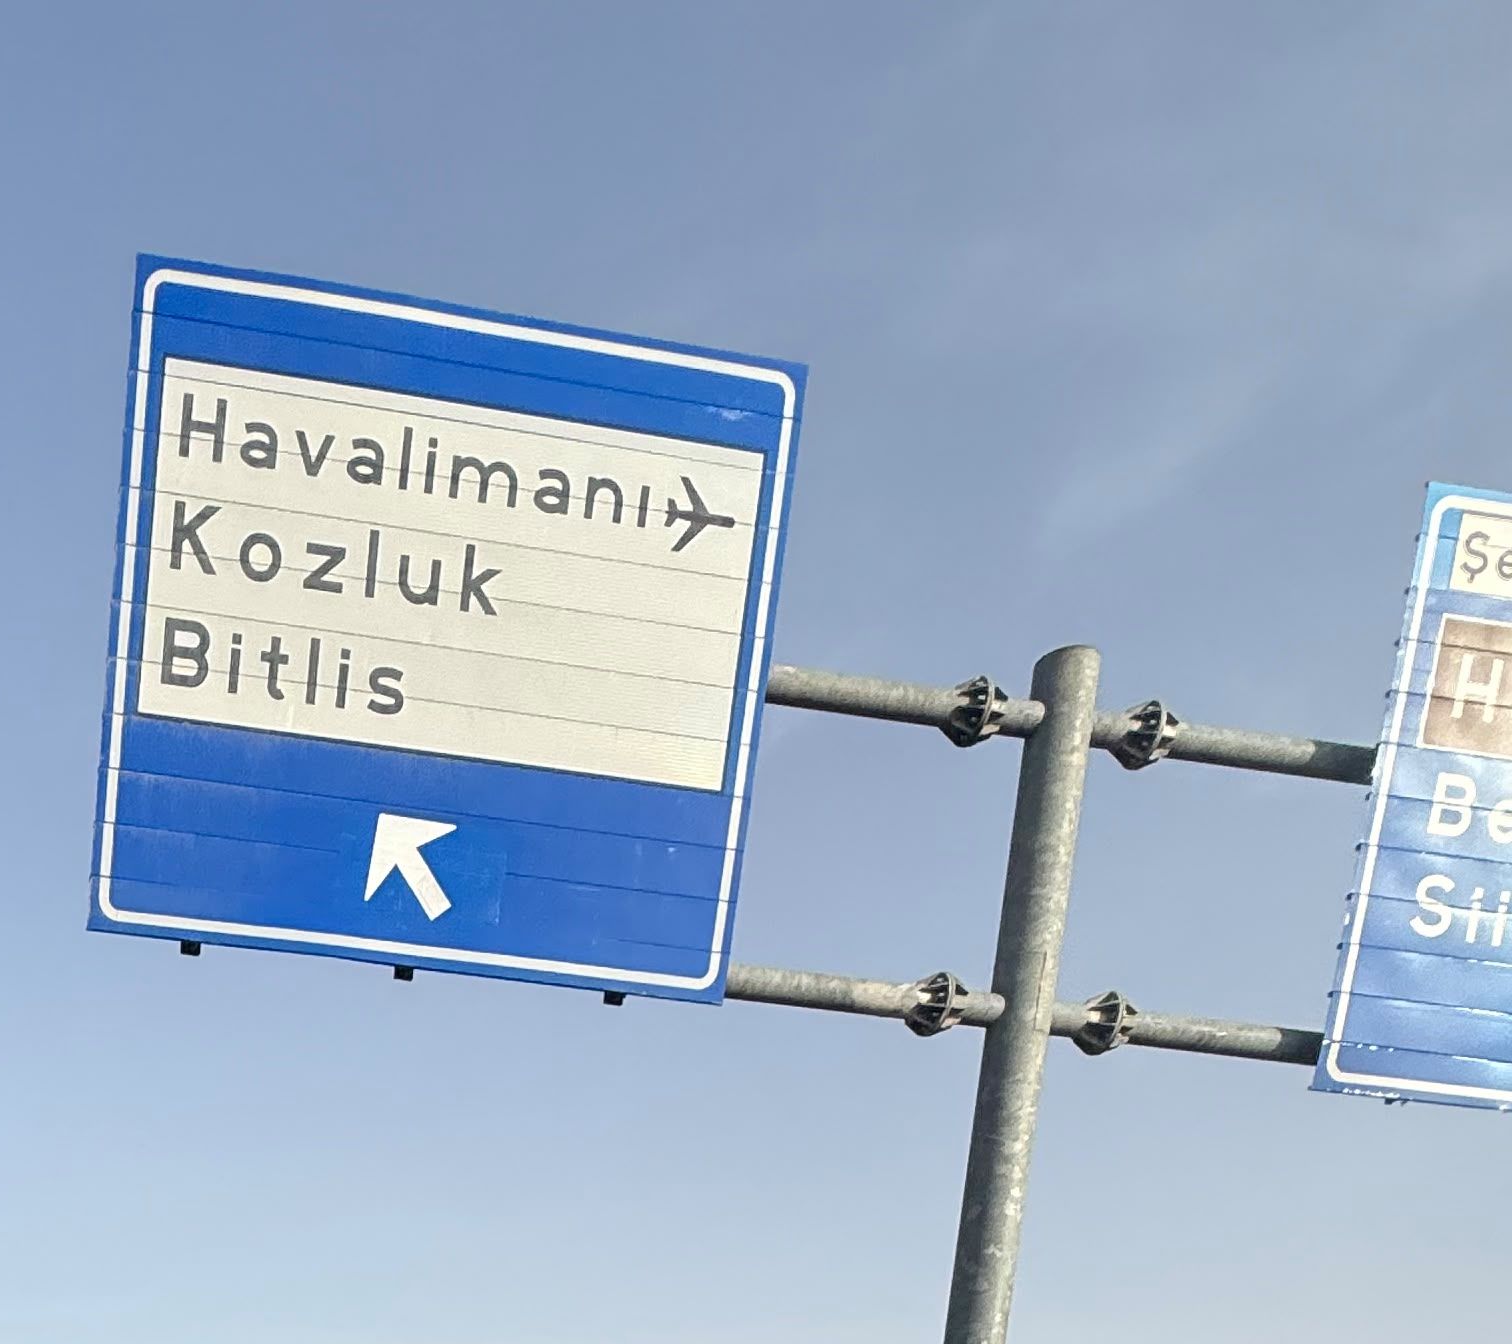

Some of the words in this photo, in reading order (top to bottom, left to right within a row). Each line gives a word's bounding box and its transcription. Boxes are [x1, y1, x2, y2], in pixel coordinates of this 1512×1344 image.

[178, 392, 650, 528] Havalimanı
[170, 500, 504, 616] Kozluk
[160, 617, 406, 715] Bitlis
